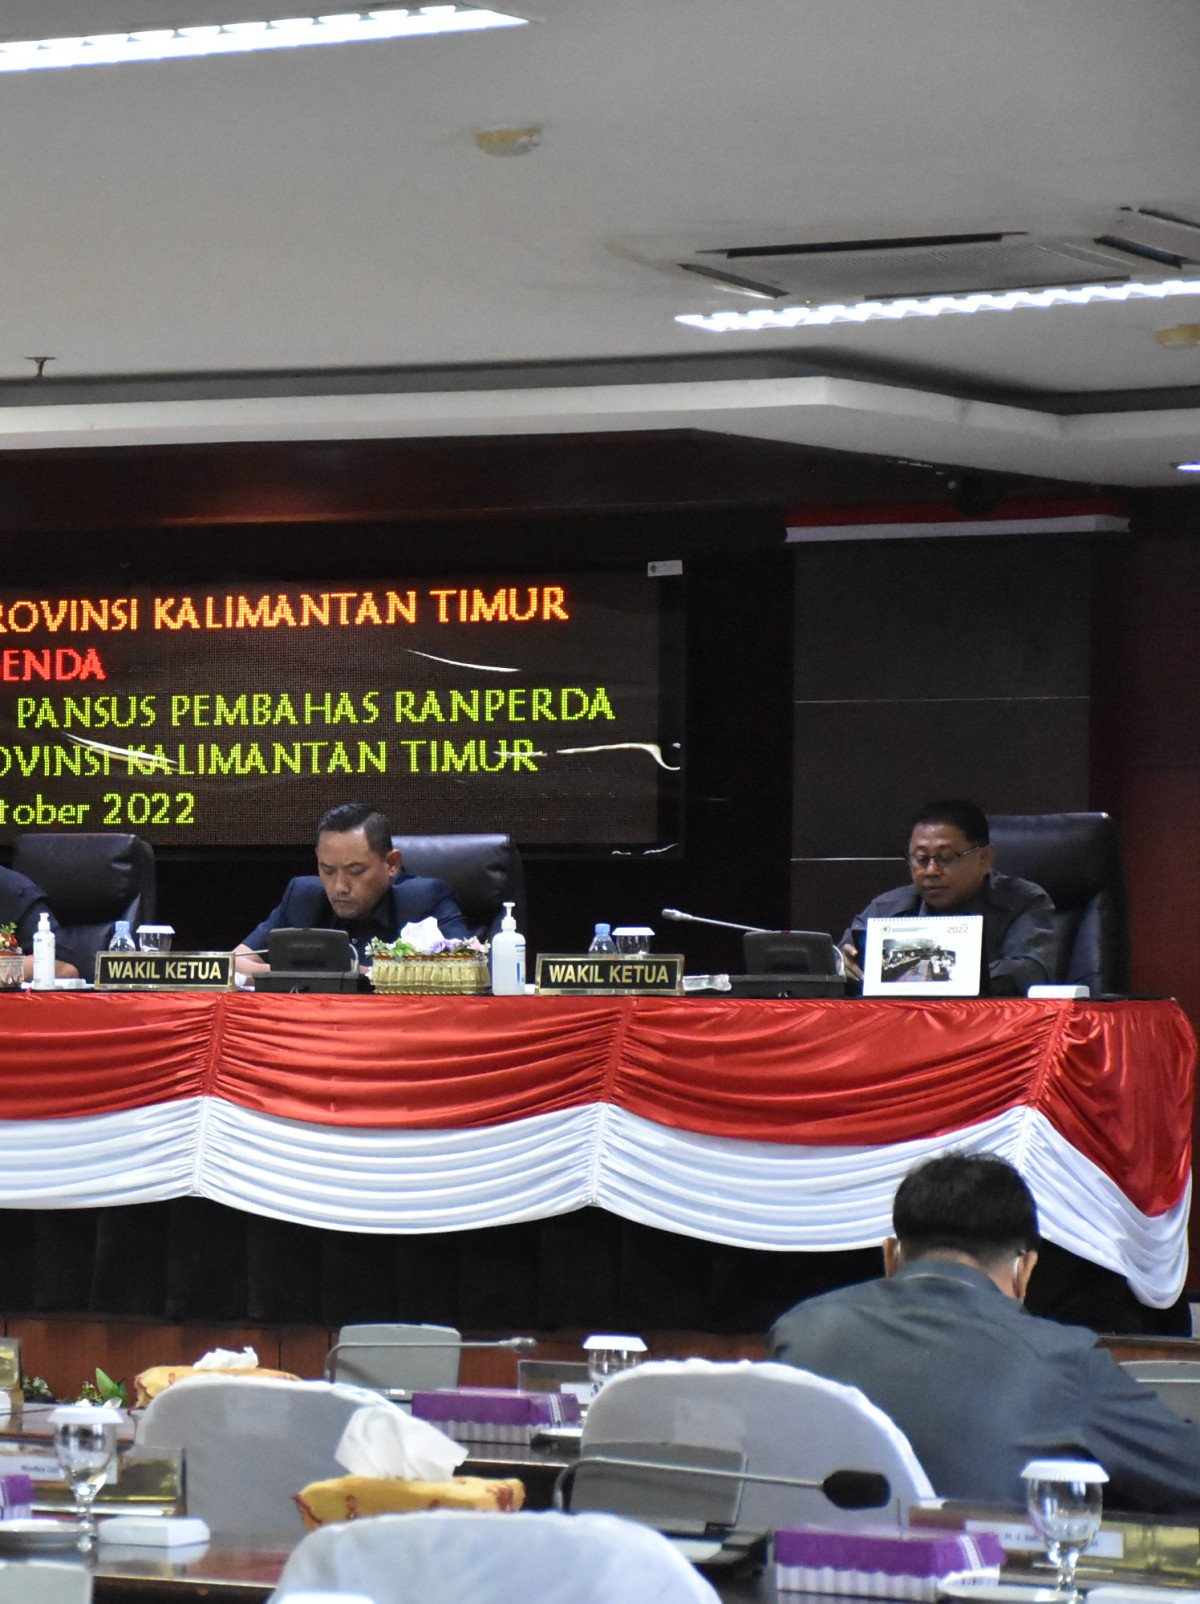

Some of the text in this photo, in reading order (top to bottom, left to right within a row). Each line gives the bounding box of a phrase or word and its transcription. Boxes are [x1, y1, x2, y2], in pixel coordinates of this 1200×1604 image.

[153, 590, 417, 630] KALIMANTAN
[430, 586, 570, 623] TIMUR
[18, 696, 156, 728] PANSUS
[172, 692, 380, 727] PEMBAHAS
[395, 688, 616, 723] RANPERDA
[127, 741, 387, 775] KALIMANTAN
[401, 739, 539, 772] TIMUR
[102, 793, 195, 824] 2022
[107, 961, 222, 979] WAKIL KETUA
[549, 965, 670, 984] WAKIL KETUA
